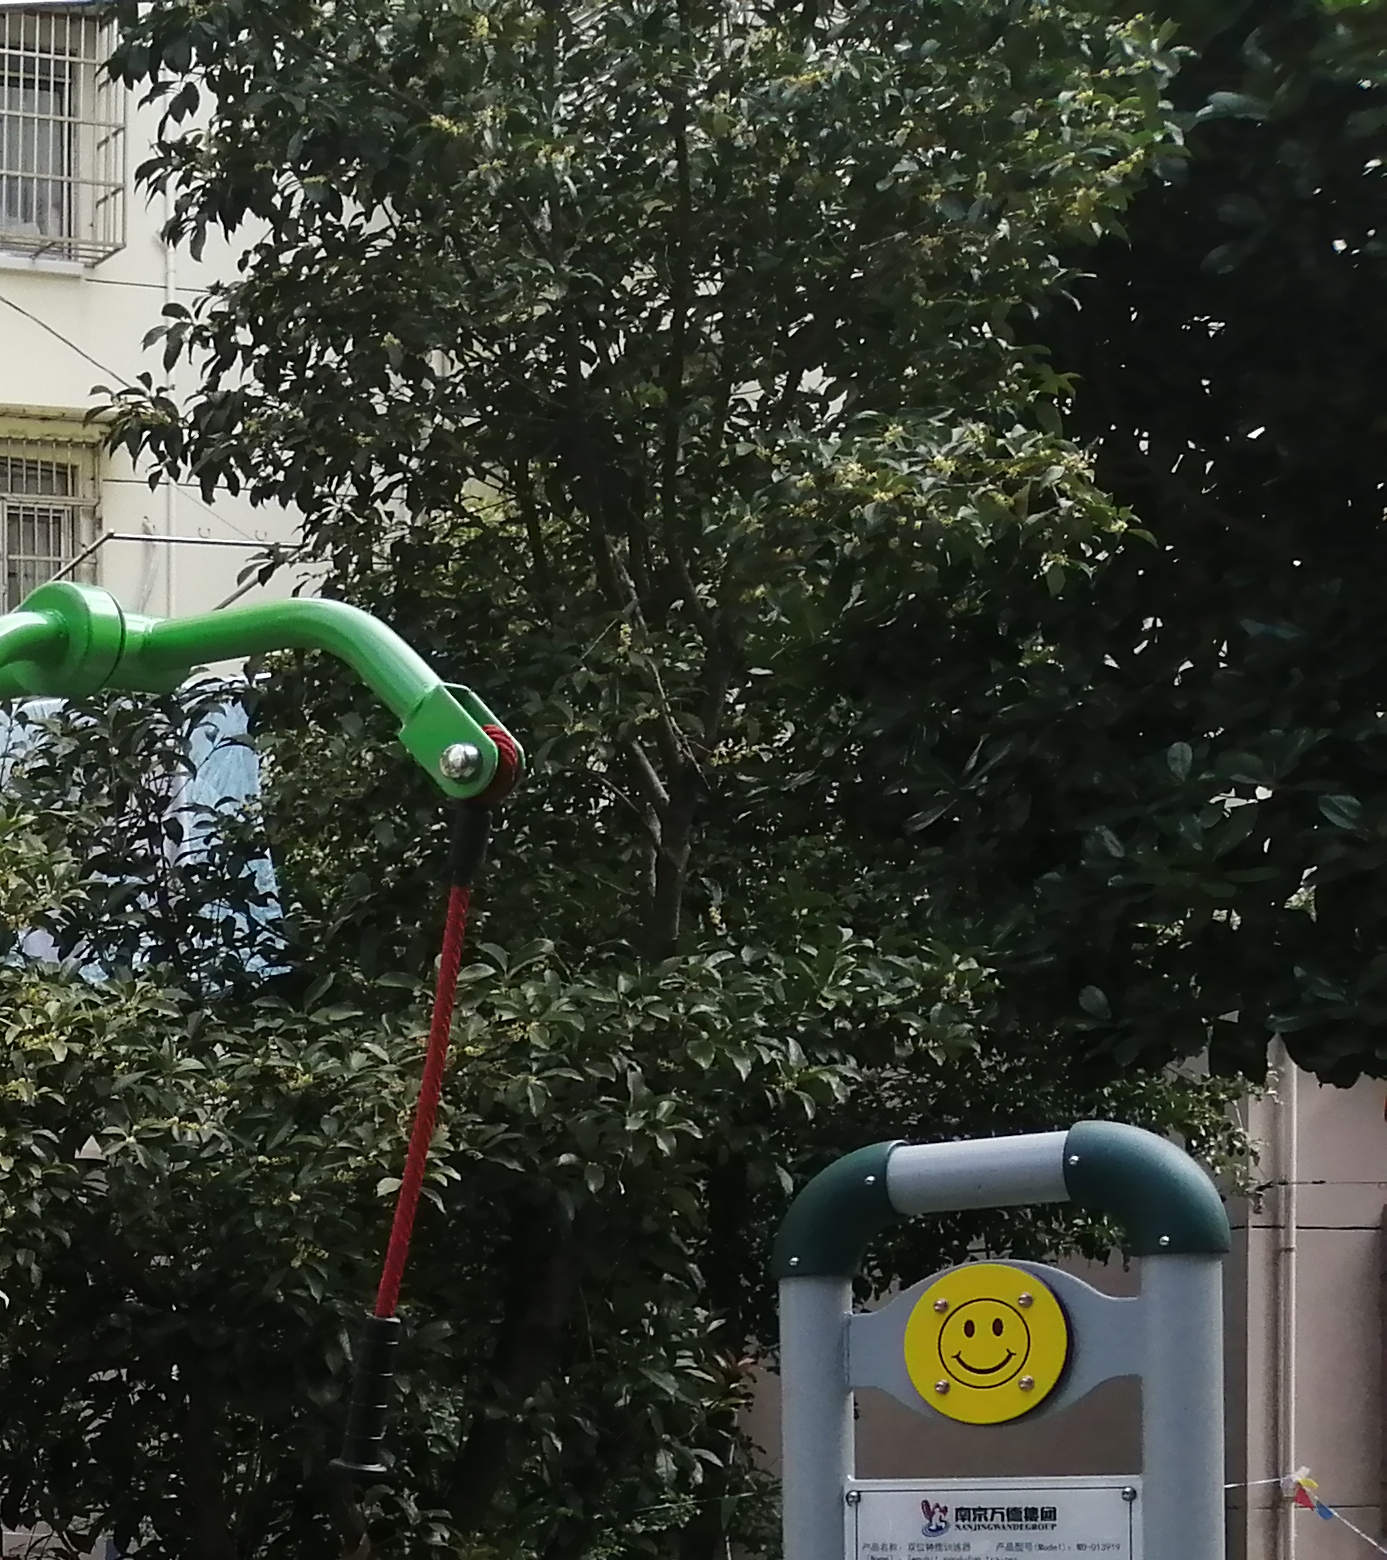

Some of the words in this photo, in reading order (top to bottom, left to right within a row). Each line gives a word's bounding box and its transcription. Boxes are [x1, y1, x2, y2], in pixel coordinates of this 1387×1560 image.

[954, 1506, 1057, 1522] 南京万德集团
